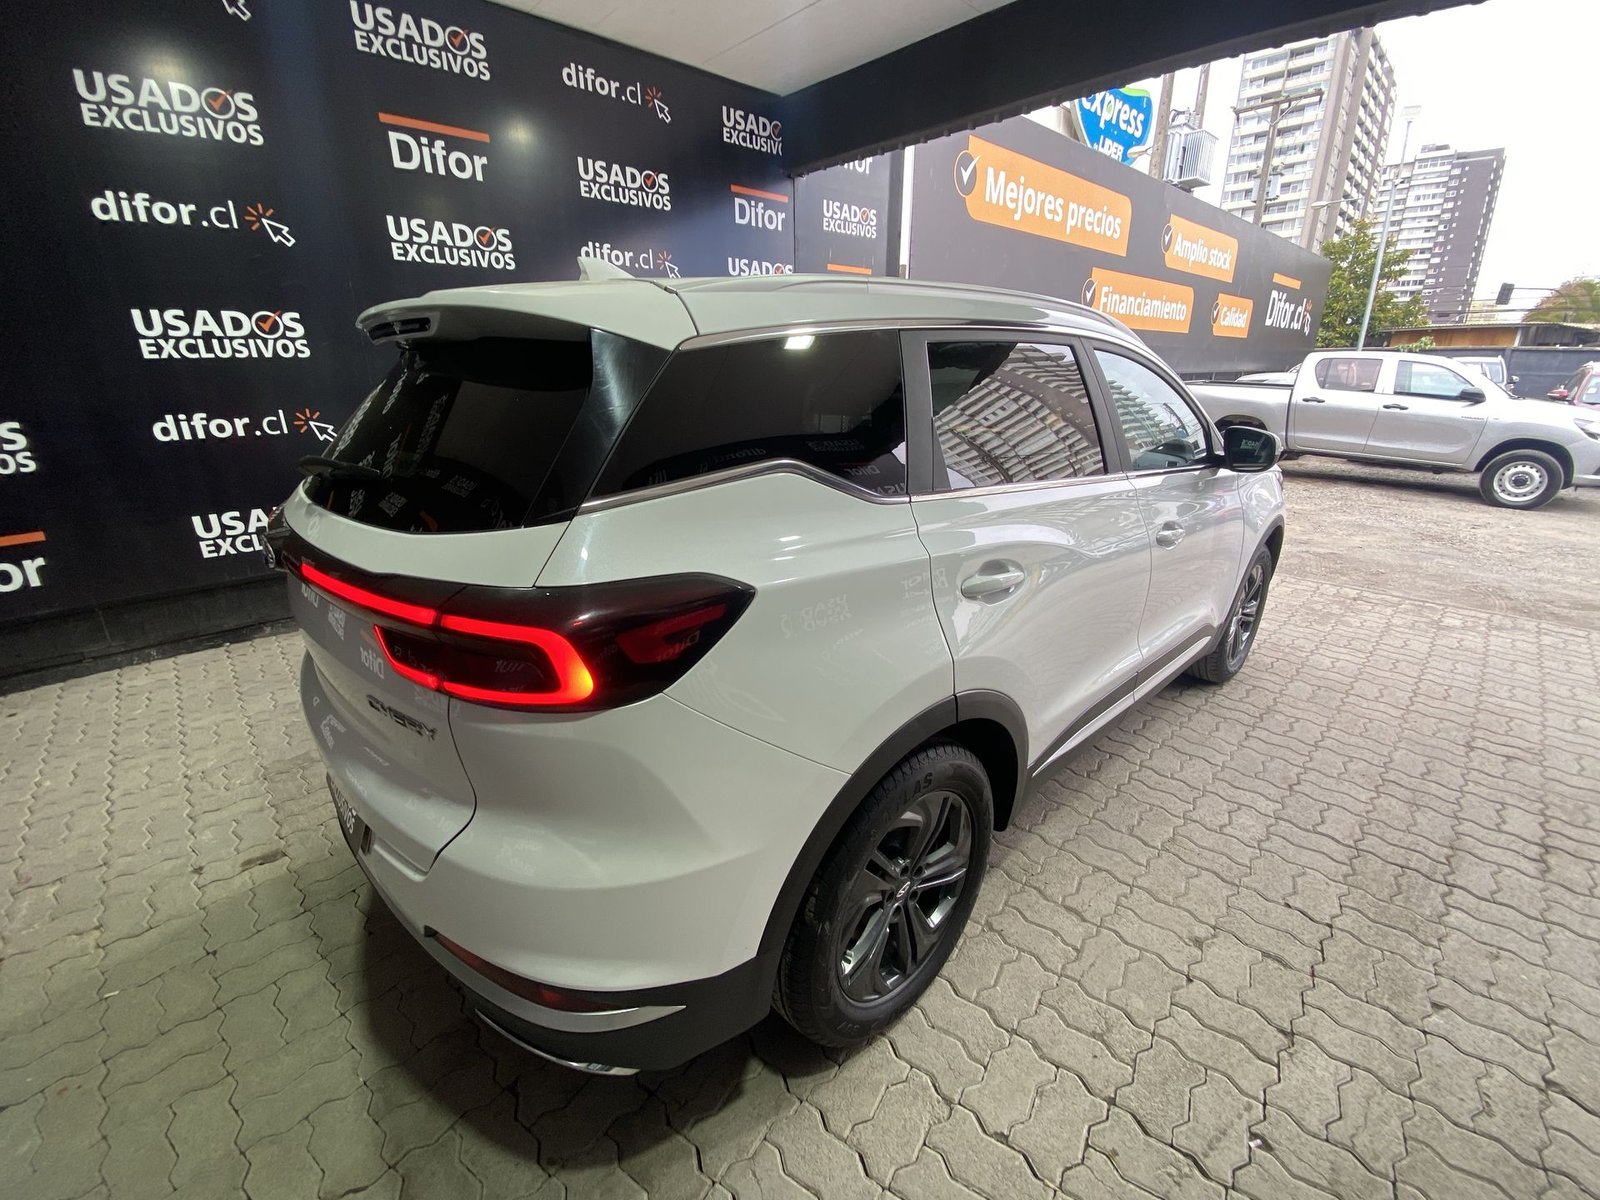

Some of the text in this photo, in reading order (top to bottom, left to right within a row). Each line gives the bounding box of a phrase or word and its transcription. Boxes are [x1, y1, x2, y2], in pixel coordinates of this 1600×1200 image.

[350, 1, 488, 60] USADOS
[354, 30, 491, 81] EXCLUSIVOS
[72, 68, 258, 122] USADOS
[562, 62, 642, 105] difor.cl
[80, 102, 264, 146] EXCLUSIVOS
[388, 130, 488, 182] Difor
[577, 156, 670, 195] USADOS
[91, 190, 239, 229] difor.cl
[579, 180, 671, 211] EXCLUSIVOS
[823, 199, 877, 226] USADOS
[985, 167, 1121, 240] Mejores precios
[734, 197, 786, 231] Difor
[823, 219, 877, 239] EXCLUSIVOS
[386, 215, 513, 251] USADOS
[390, 242, 516, 271] EXCLUSIVOS
[580, 241, 653, 269] difor.cl
[1174, 234, 1231, 270] Amplio stock
[1099, 287, 1187, 322] Financiamiento
[1220, 306, 1248, 329] Calidad
[1265, 290, 1307, 330] Difor.cl
[130, 308, 305, 339] USADOS
[138, 338, 311, 360] EXCLUSIVOS
[152, 409, 289, 442] difor.cl
